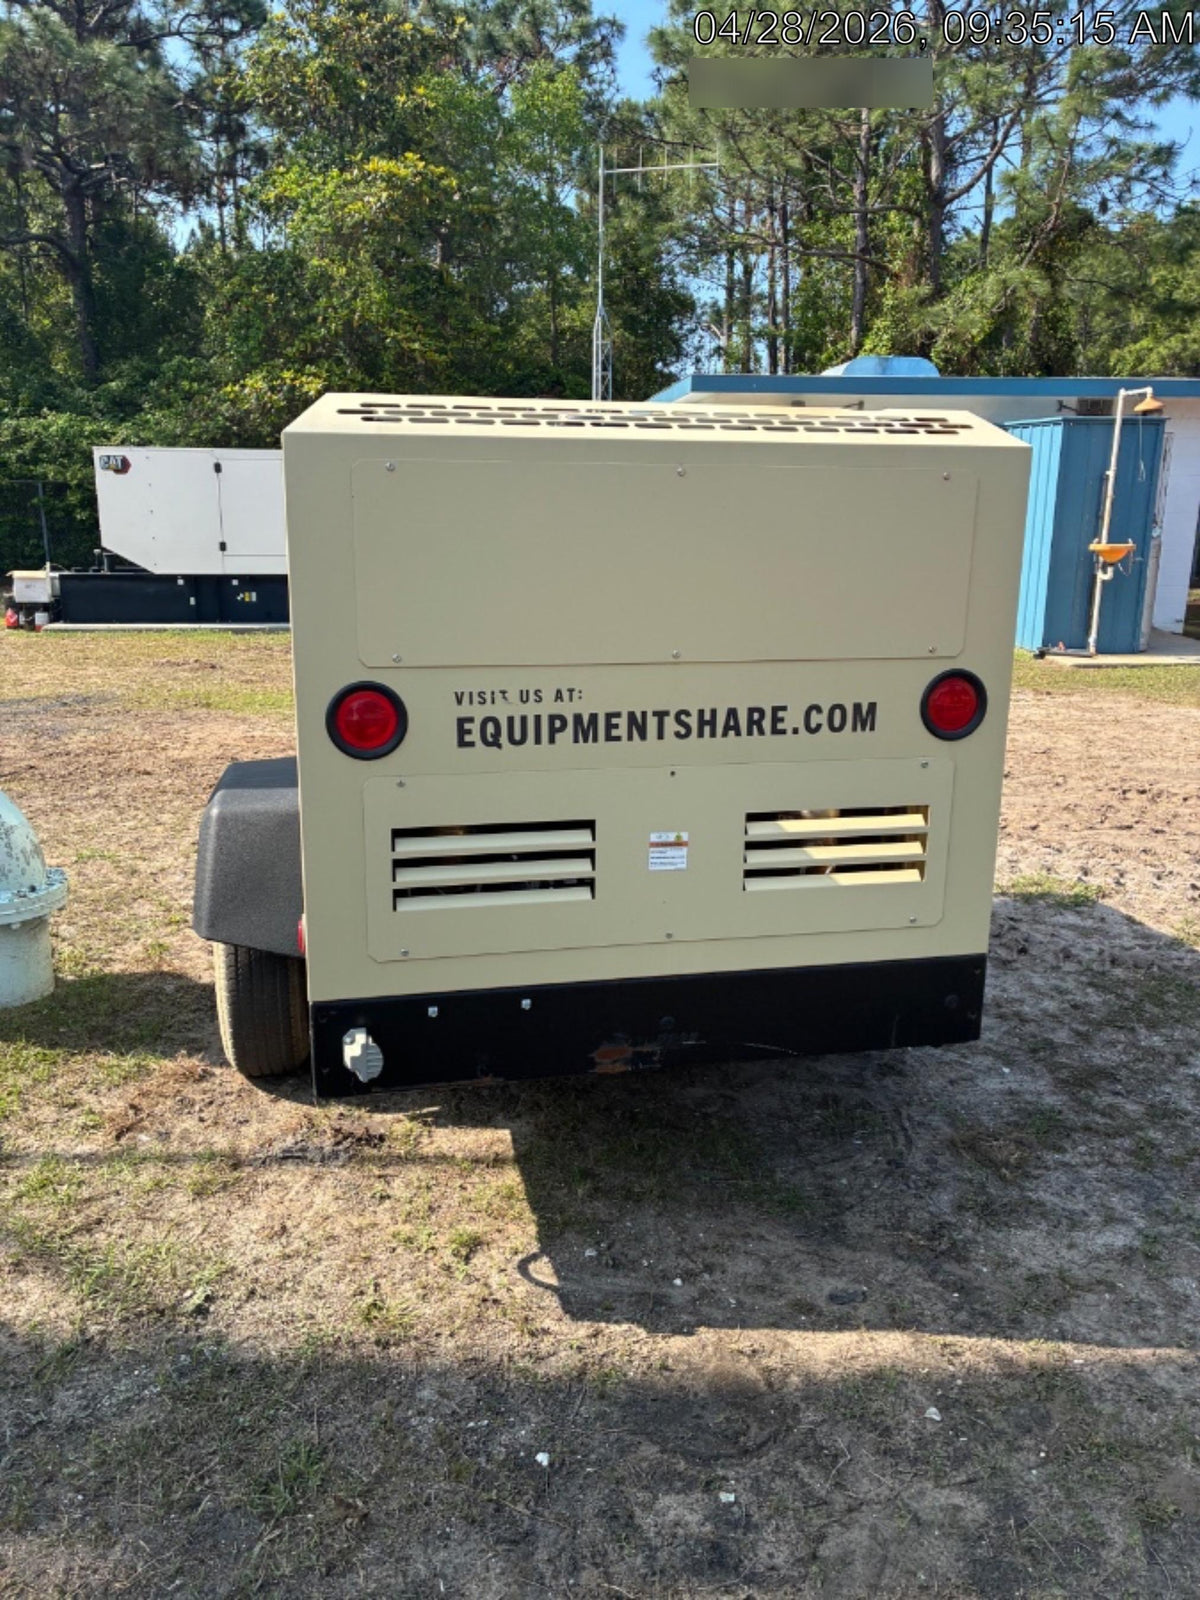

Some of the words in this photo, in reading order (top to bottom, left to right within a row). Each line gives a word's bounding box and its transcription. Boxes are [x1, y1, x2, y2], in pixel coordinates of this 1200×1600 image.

[100, 455, 124, 470] CAT
[454, 690, 508, 706] VISIT
[519, 689, 543, 704] US
[554, 688, 582, 703] AT:
[456, 701, 878, 749] EQUIPMENTSHARE.COM
